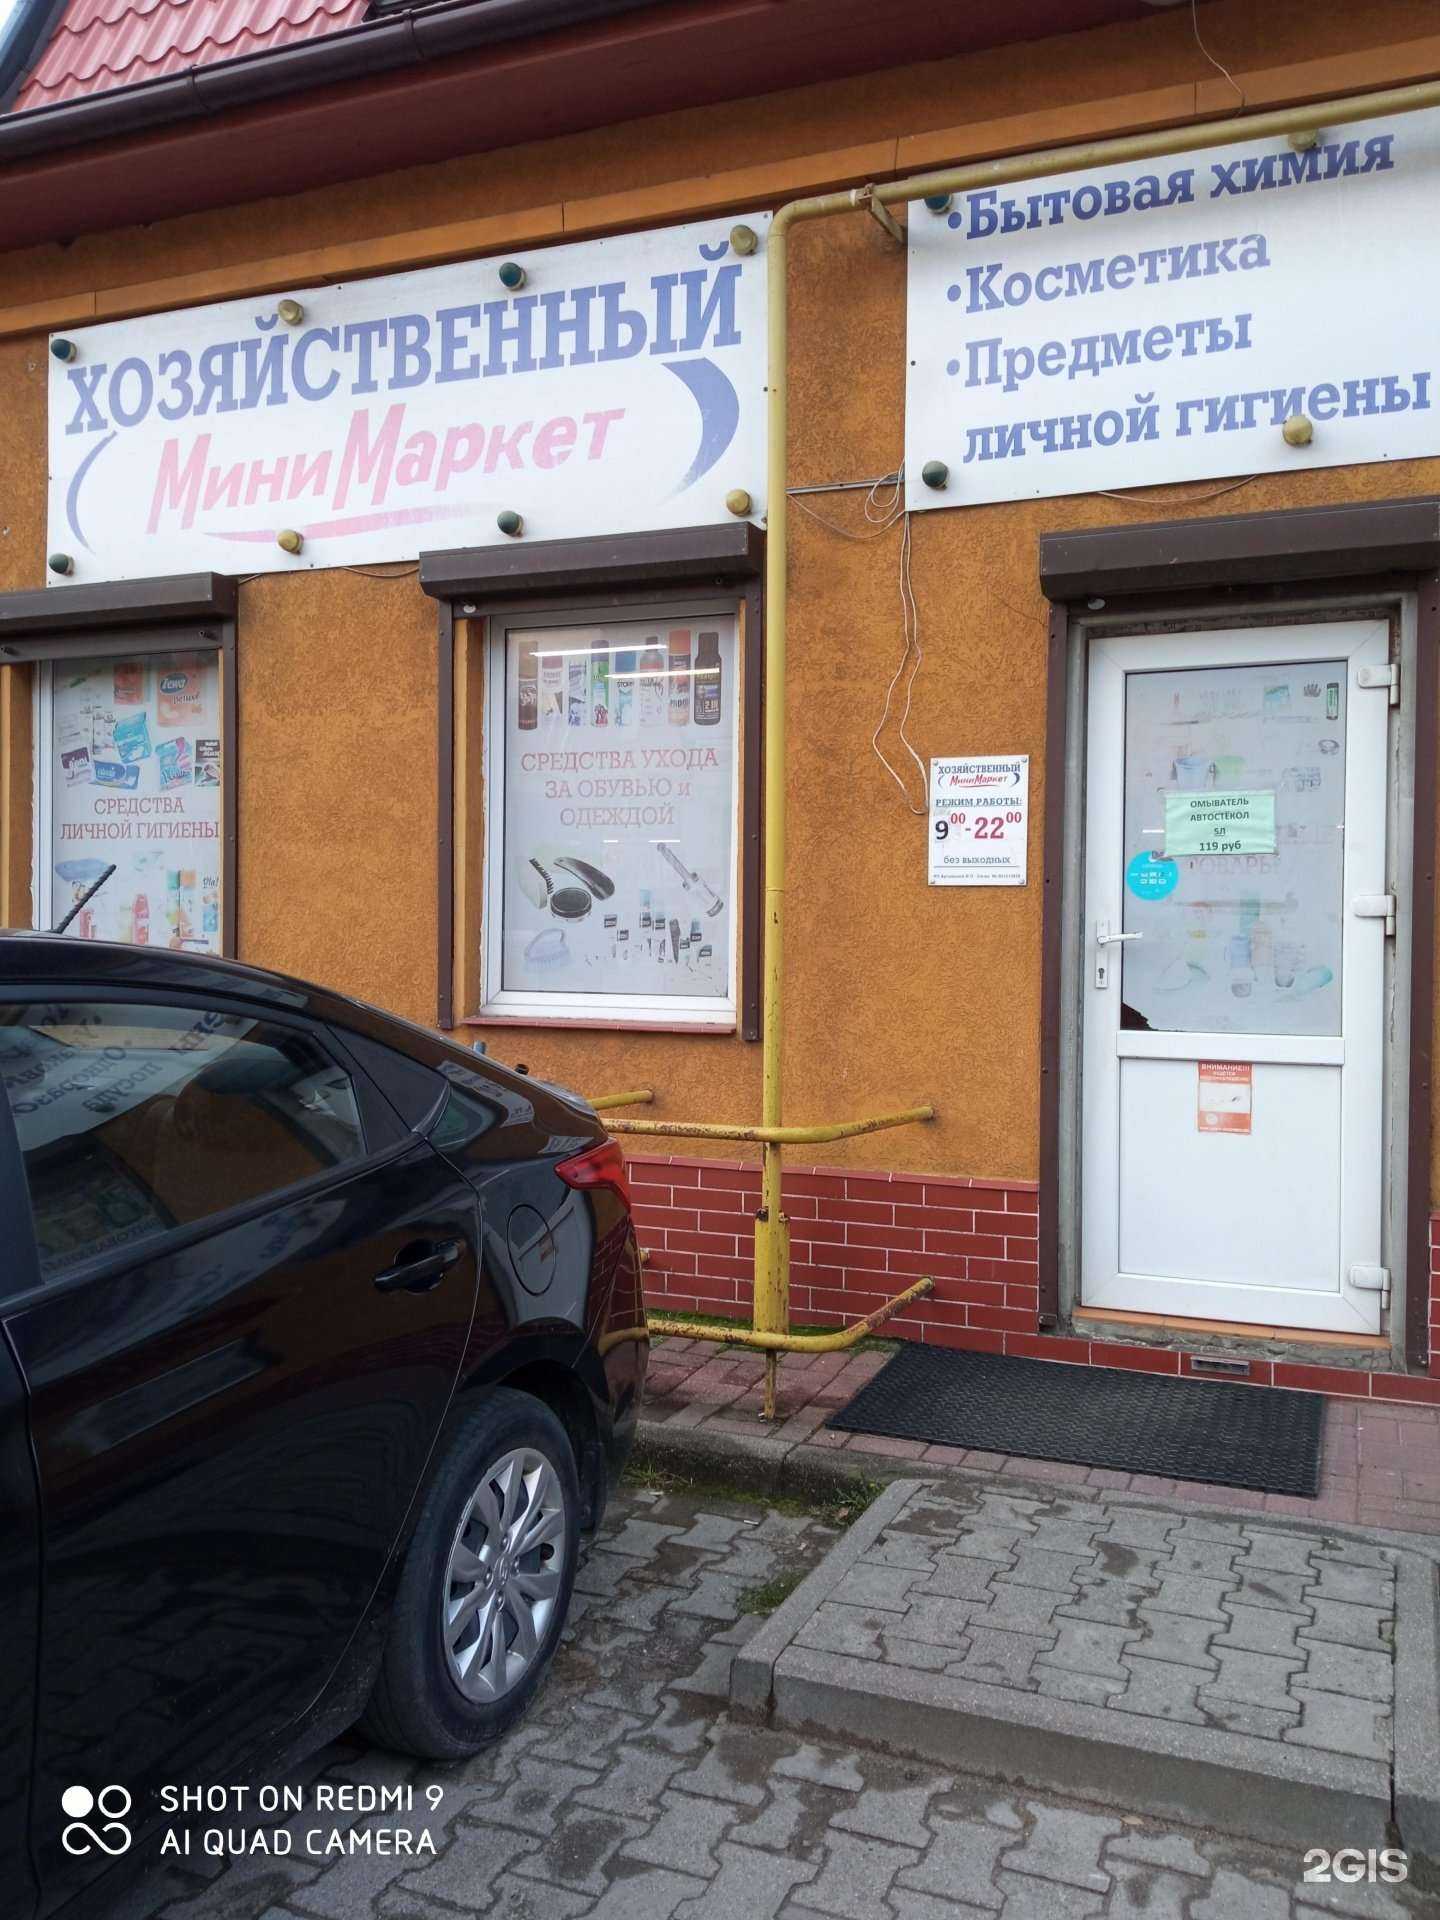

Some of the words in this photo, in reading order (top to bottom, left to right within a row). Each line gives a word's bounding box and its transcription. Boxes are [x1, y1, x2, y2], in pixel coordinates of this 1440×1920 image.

[966, 168, 1195, 240] Бытовая
[1210, 134, 1394, 199] химия
[965, 232, 1271, 314] Косметика
[65, 241, 743, 436] ХОЗЯЙСТВЕННЫЙ
[964, 313, 1252, 393] Предметы
[963, 391, 1160, 464] личной
[1175, 372, 1431, 437] гигиены
[145, 402, 626, 535] МиниМаркет
[521, 750, 635, 773] СРЕДСТВА
[642, 748, 719, 770] УХОДА
[938, 761, 1021, 775] ХОЗЯЙСТВЕННЫЙ
[544, 780, 571, 800] ЗА
[577, 778, 673, 799] ОБУВЬЮ
[949, 774, 1008, 786] МиниМаркет
[94, 797, 185, 816] СРЕДСТВА
[935, 798, 973, 807] РЕЖИМ
[976, 797, 1022, 806] РАБОТЫ:
[1190, 798, 1249, 808] ОМЫВАТЕЛЬ
[560, 805, 675, 828] ОДЕЖДОЙ
[1190, 811, 1249, 822] АВТОСТЕКОЛ
[60, 819, 132, 840] ЛИЧНОЙ
[137, 821, 220, 839] ГИГИЕНЫ
[1200, 842, 1218, 851] 119
[1222, 840, 1241, 852] руб
[943, 856, 960, 864] без
[962, 856, 1011, 864] выходных
